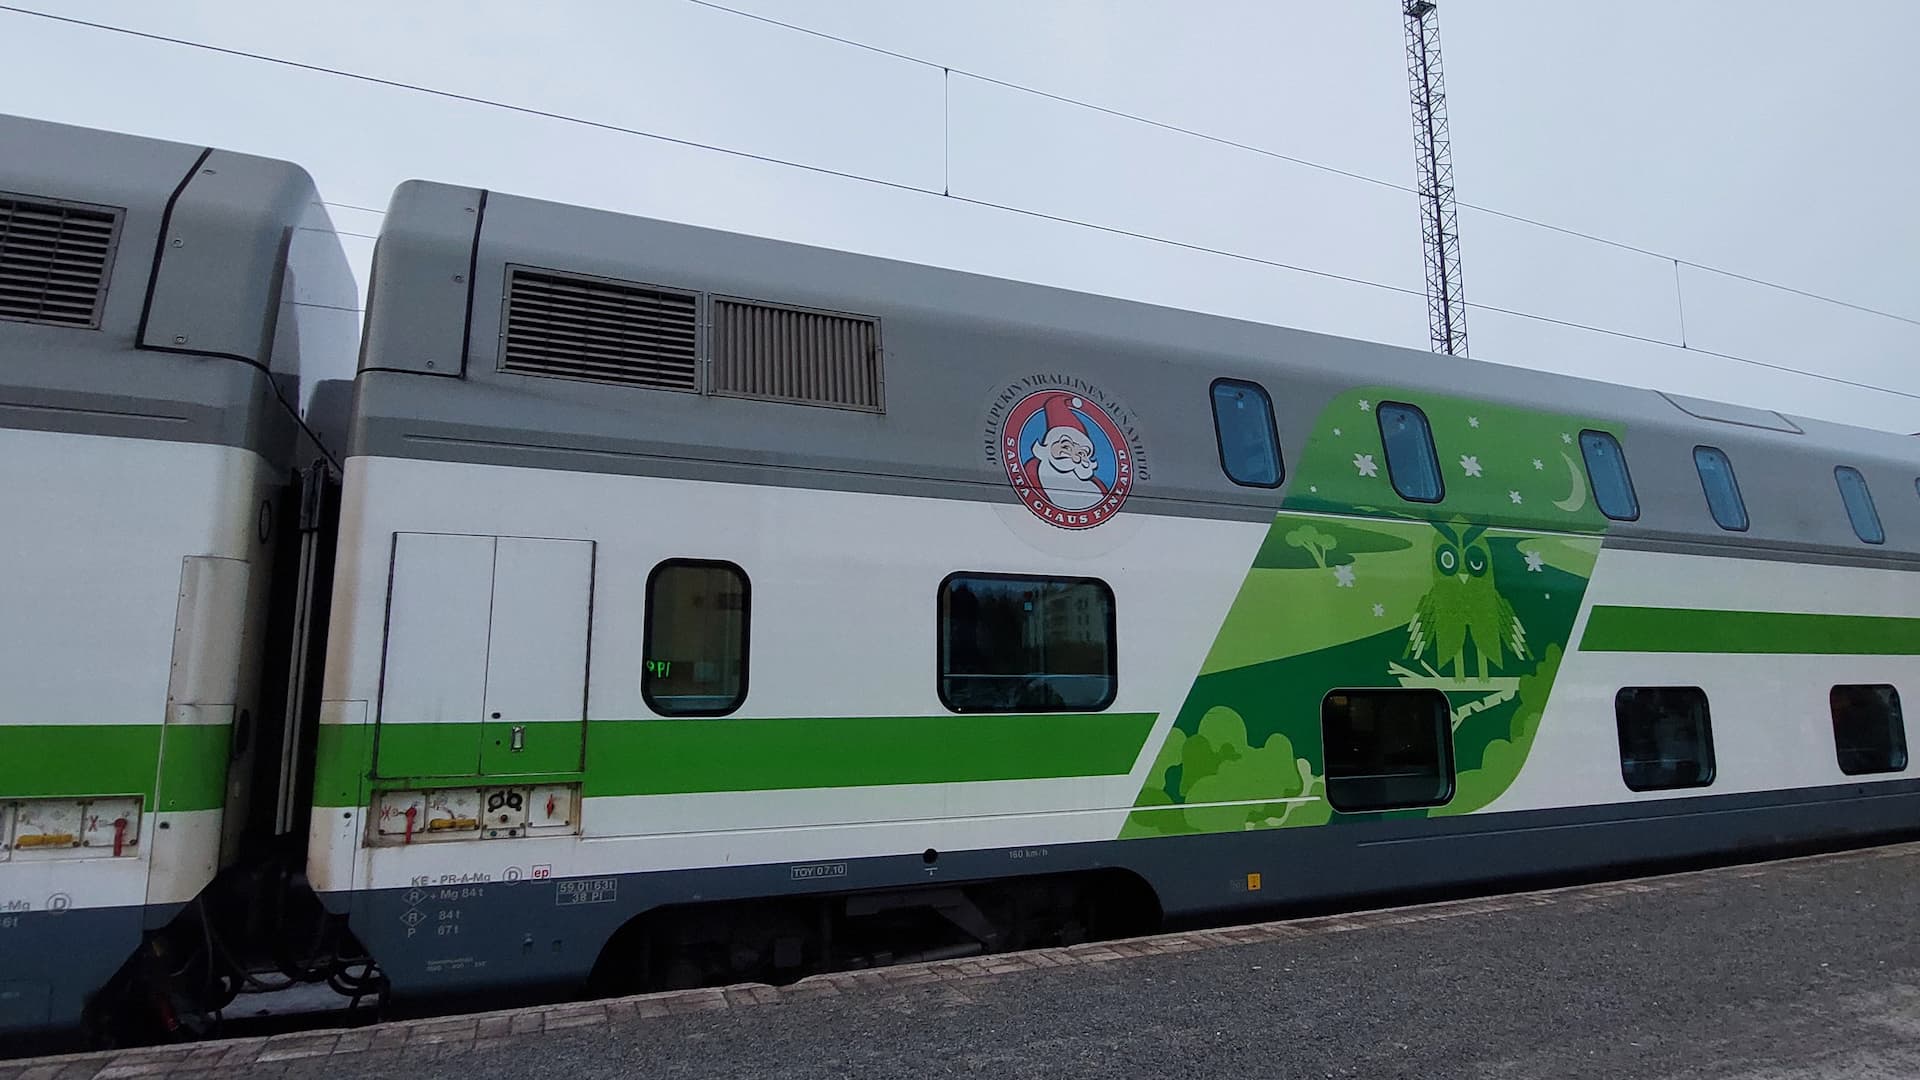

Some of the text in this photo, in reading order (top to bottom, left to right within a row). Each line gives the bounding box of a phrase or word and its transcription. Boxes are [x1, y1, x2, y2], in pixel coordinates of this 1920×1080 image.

[1006, 437, 1129, 524] SANTA CLAUS FINLAND
[411, 875, 429, 887] KE
[534, 869, 549, 881] ep
